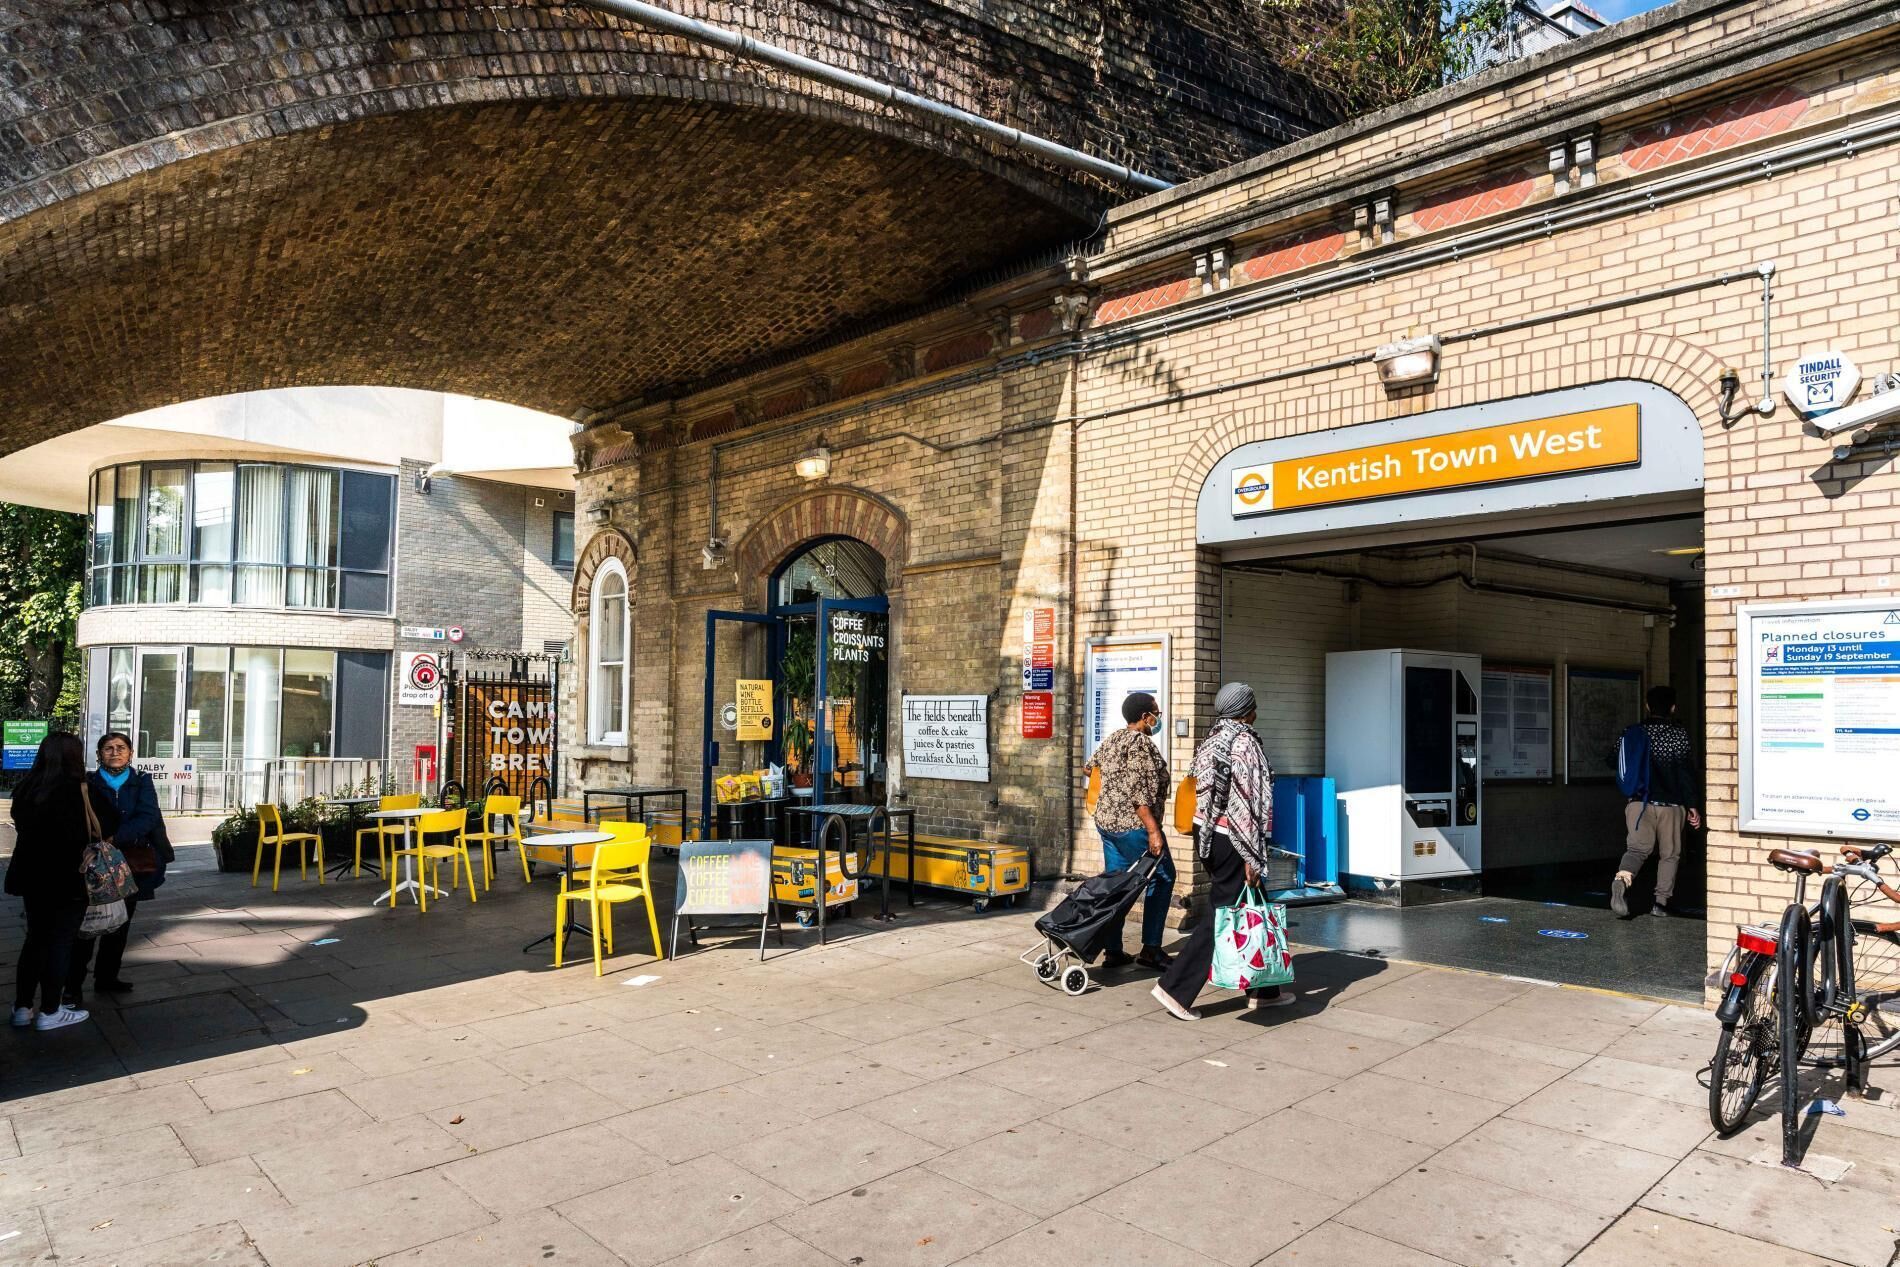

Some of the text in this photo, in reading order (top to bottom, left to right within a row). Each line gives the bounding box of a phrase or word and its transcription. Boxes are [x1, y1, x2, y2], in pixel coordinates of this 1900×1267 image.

[1799, 358, 1842, 375] TINDALL
[1800, 371, 1841, 384] SECURITY
[1296, 425, 1602, 491] Kentish Town West
[833, 617, 863, 631] COFFEE
[833, 633, 884, 648] CROISSANTS
[1762, 630, 1886, 643] Planned closures
[833, 647, 869, 662] PLANTS
[1786, 643, 1863, 655] Monday 13 until
[1786, 651, 1892, 663] Sunday 19 September
[740, 684, 765, 692] NATURAL
[740, 691, 755, 699] WINE
[740, 698, 762, 706] BOTTLE
[740, 705, 764, 713] REFILLS
[907, 700, 982, 722] The fields beneath
[918, 725, 969, 737] coffee & cake
[914, 738, 976, 753] juices & pastries
[911, 751, 979, 766] breakfast & lunch
[137, 764, 166, 772] DALBY
[173, 772, 192, 780] NW5
[690, 855, 729, 870] COFFEE
